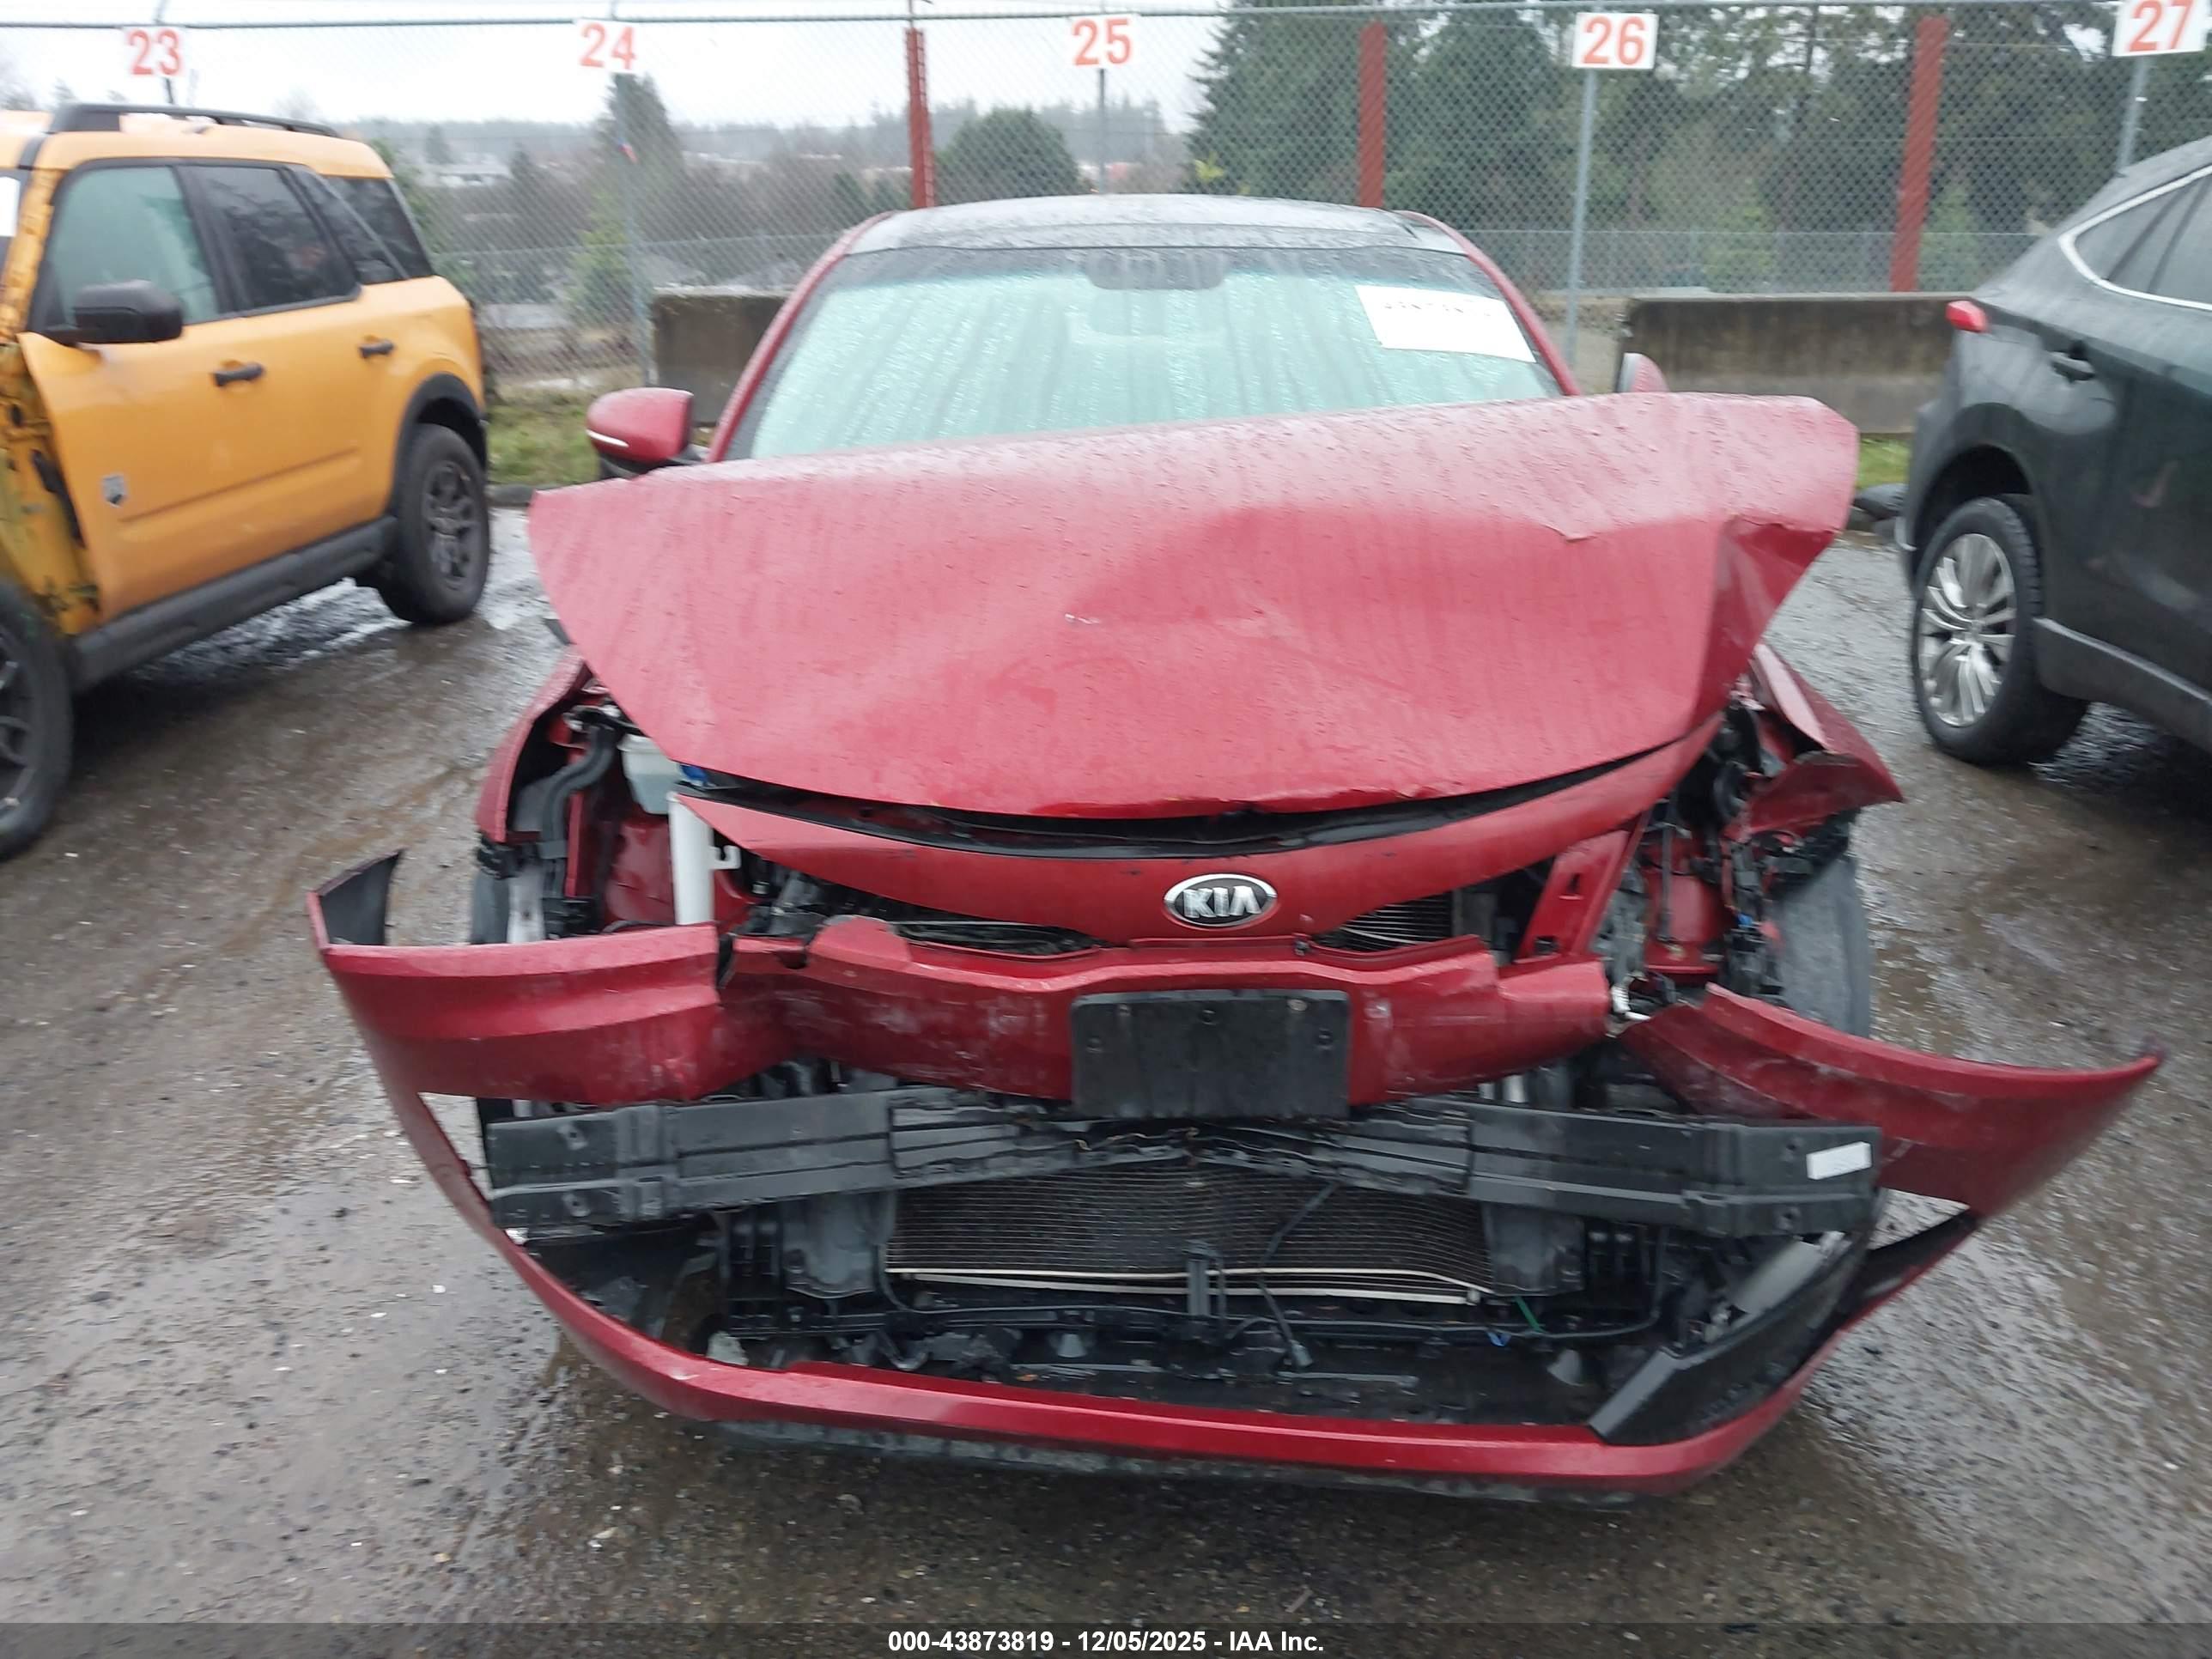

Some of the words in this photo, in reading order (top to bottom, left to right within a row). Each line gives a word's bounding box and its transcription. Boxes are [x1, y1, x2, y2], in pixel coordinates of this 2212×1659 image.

[580, 23, 637, 70] 24
[1073, 19, 1130, 65] 25
[1583, 16, 1645, 65] 26
[2129, 0, 2194, 52] 27
[129, 30, 179, 75] 23
[1182, 885, 1262, 918] KIA
